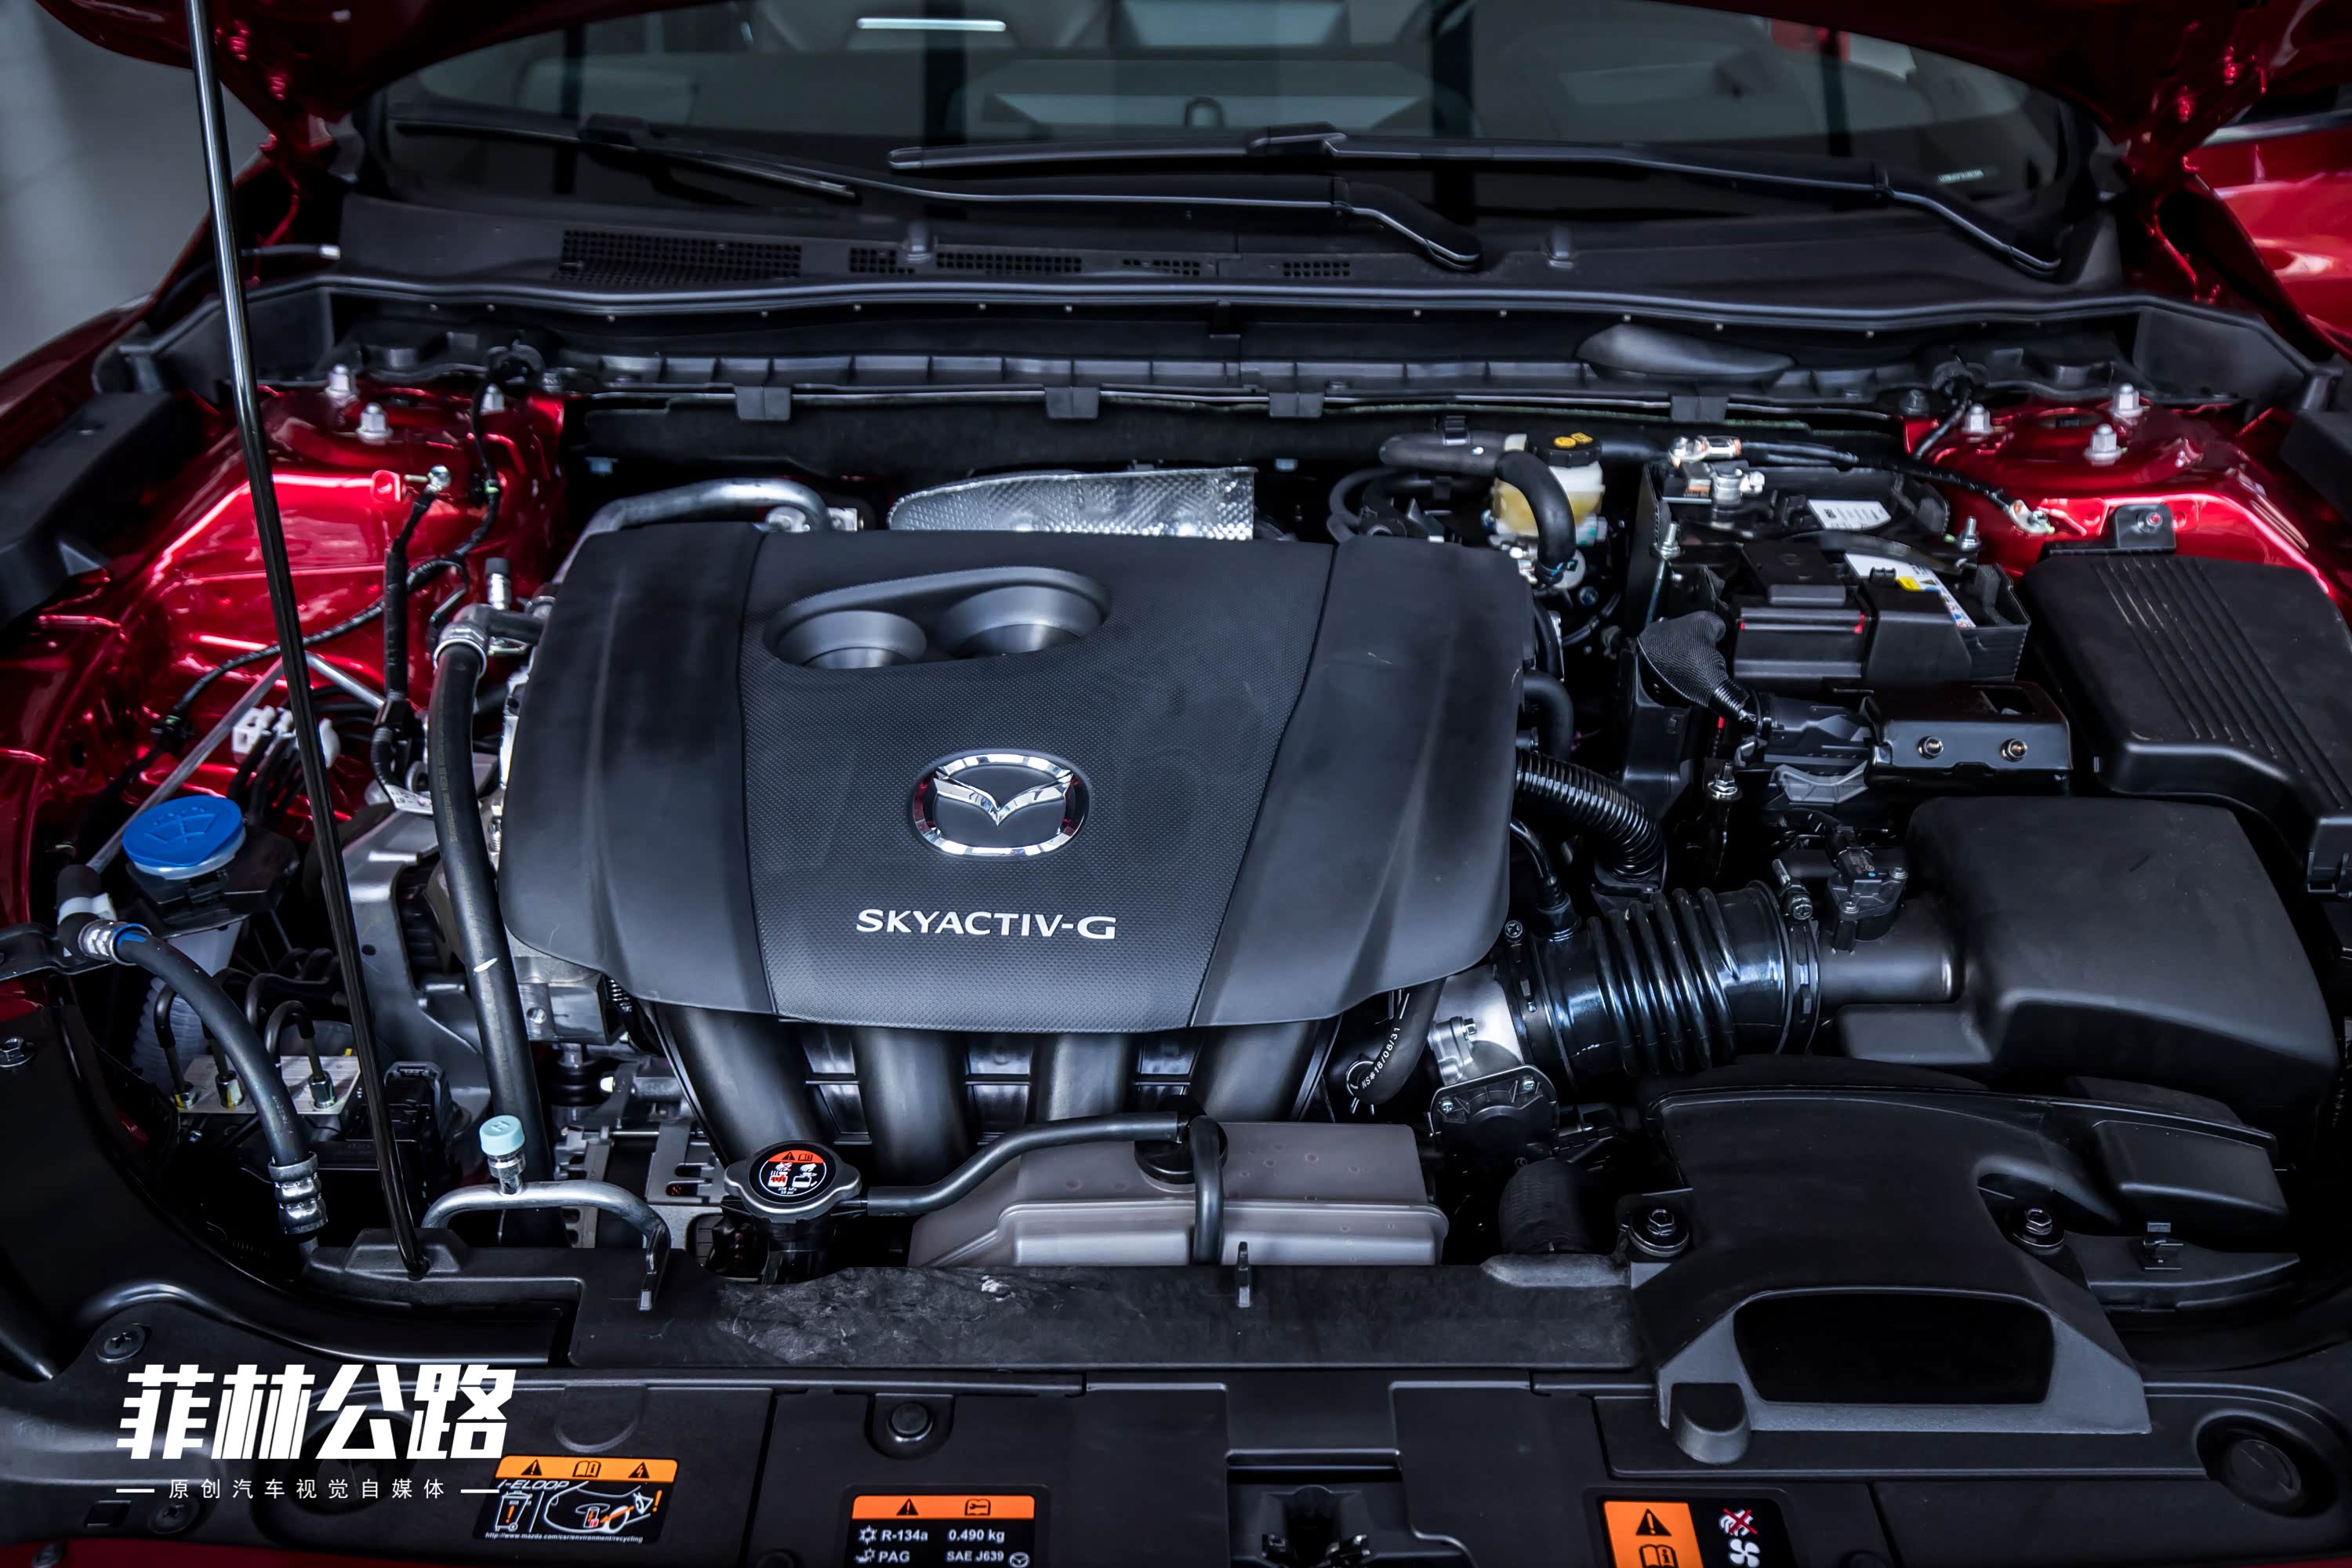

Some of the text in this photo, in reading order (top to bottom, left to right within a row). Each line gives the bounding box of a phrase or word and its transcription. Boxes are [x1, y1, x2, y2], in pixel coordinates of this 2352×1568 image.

[856, 908, 1116, 939] SKYACTIV-G
[881, 1530, 1005, 1544] R-134a 0.490 kg
[878, 1550, 1004, 1563] PAG SAE J639
